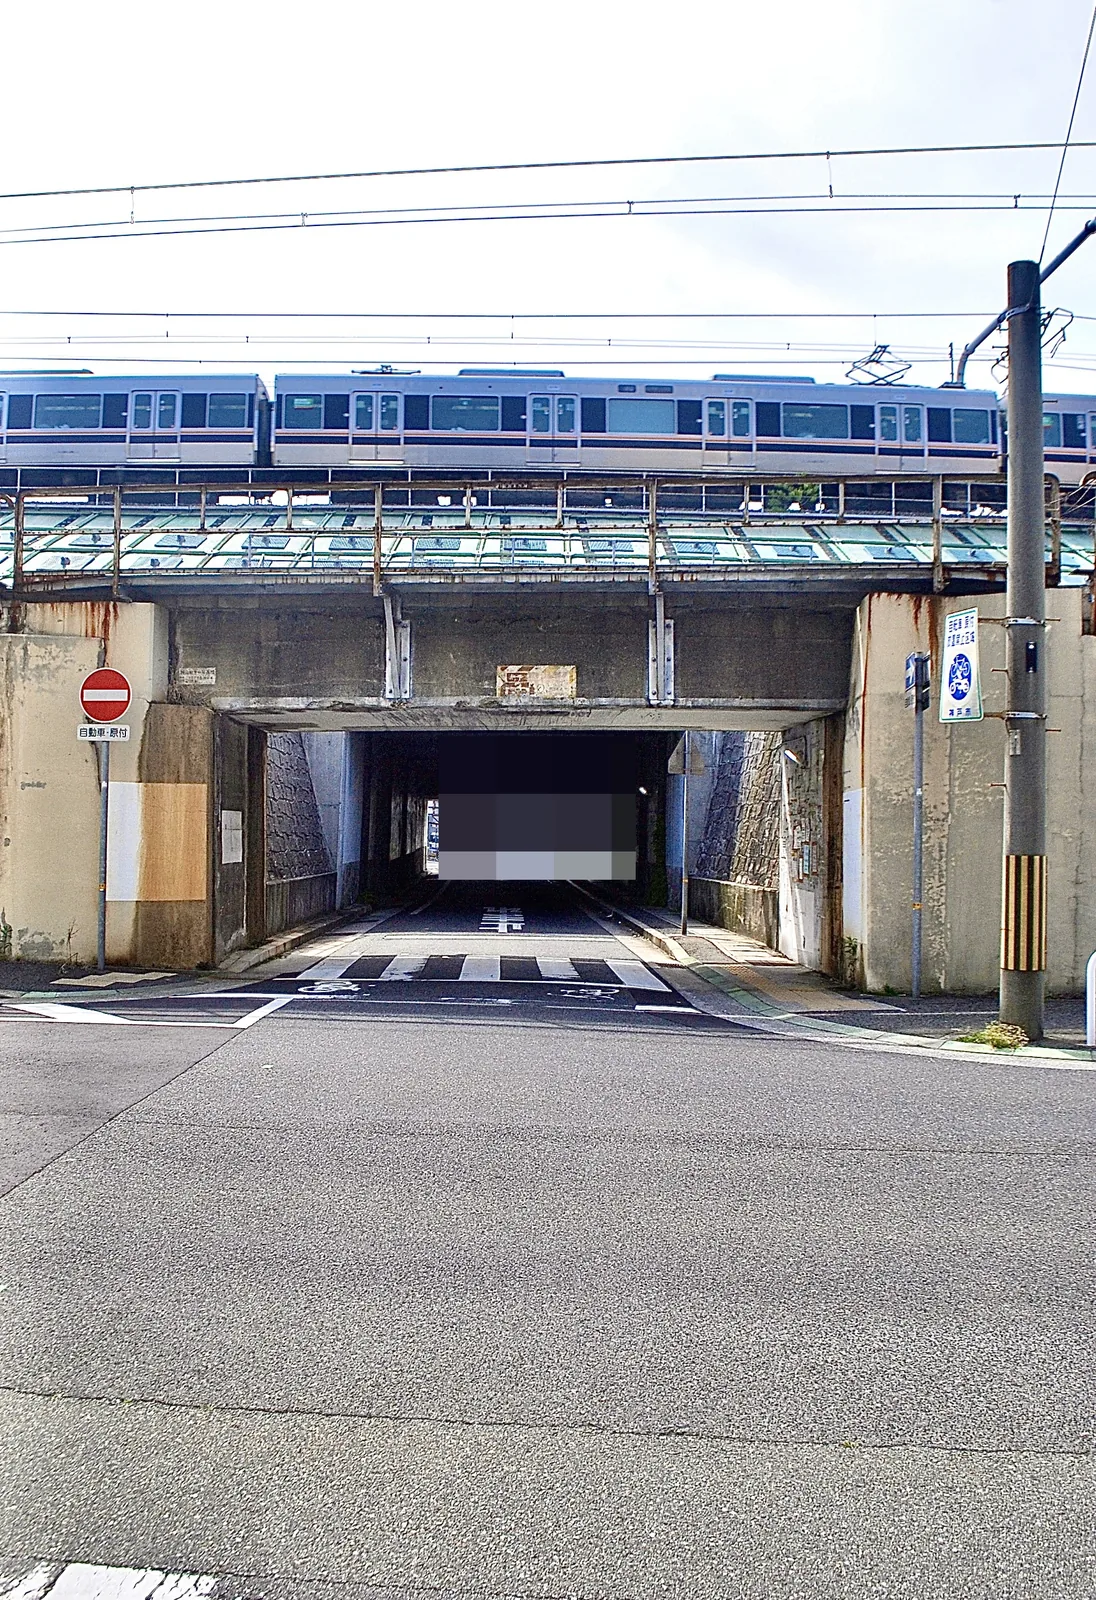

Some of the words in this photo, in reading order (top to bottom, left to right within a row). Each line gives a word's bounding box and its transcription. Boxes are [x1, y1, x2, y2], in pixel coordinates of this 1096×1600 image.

[79, 727, 127, 737] 自動車・原付
